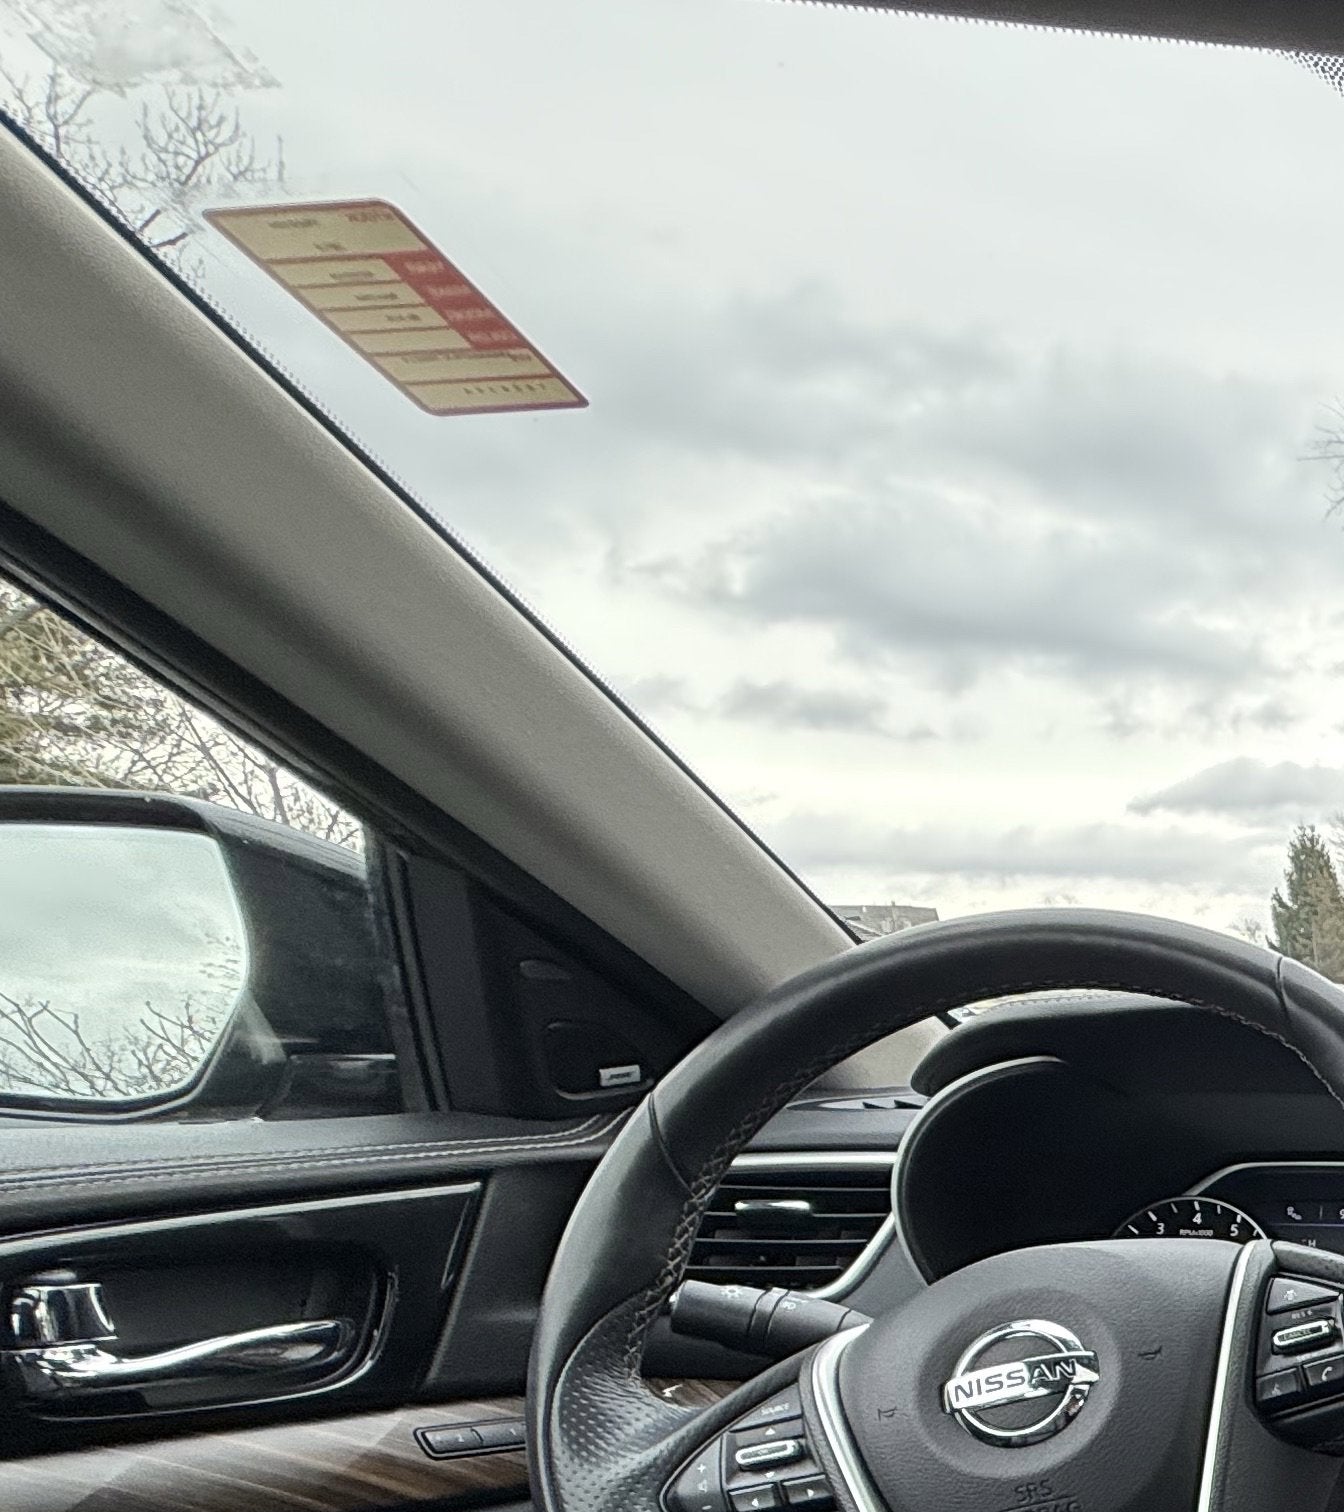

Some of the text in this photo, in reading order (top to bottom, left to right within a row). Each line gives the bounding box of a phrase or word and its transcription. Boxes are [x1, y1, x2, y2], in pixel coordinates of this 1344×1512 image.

[1192, 1212, 1202, 1225] 4
[1156, 1222, 1165, 1236] 3
[1229, 1223, 1239, 1237] 5
[953, 1358, 1078, 1403] NISSAN
[1014, 1478, 1053, 1502] SRS
